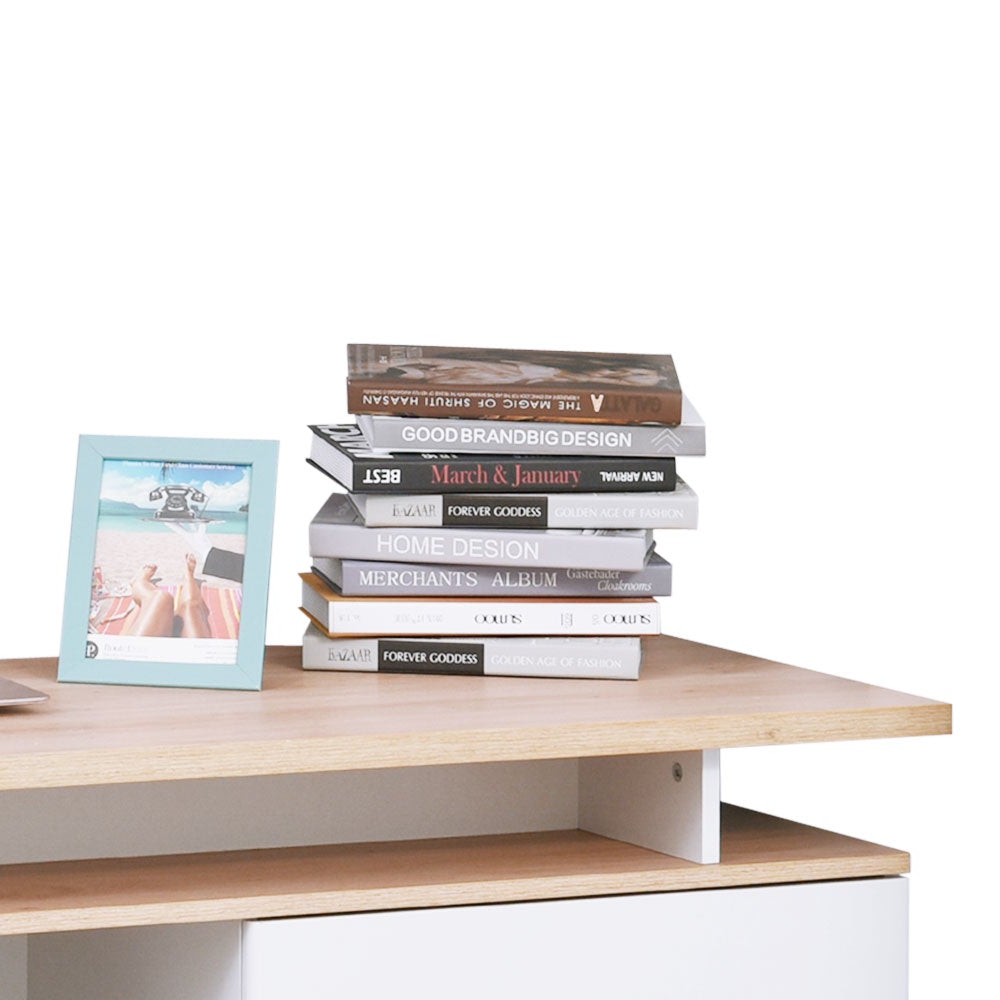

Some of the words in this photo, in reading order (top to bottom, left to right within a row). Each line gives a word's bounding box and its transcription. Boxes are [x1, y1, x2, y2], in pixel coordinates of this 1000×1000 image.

[363, 394, 419, 407] HAASAN
[425, 396, 471, 409] SHRUTI
[477, 397, 501, 409] OF
[503, 398, 552, 410] MAGIC
[558, 399, 582, 411] THE
[402, 426, 456, 444] GOOD
[461, 427, 559, 447] BRANDBIG
[562, 429, 632, 448] DESIGN
[363, 468, 401, 484] BEST
[431, 464, 491, 485] March
[494, 465, 509, 485] &
[512, 464, 582, 488] January
[600, 470, 641, 482] ARRIVAL
[643, 470, 664, 482] NEW
[392, 503, 437, 518] BAZAAR
[447, 504, 491, 518] FOREVER
[494, 505, 542, 519] GODDESS
[555, 506, 598, 519] GOLDEN
[601, 507, 620, 519] AGE
[623, 507, 636, 519] OF
[639, 507, 684, 519] FASHION
[377, 534, 445, 556] HOME
[359, 570, 478, 587] MERCHANTS
[492, 570, 558, 588] ALBUM
[597, 579, 653, 592] Cloakrooms
[327, 648, 372, 662] BAZAAR
[383, 649, 428, 664] FOREVER
[430, 650, 478, 665] GODDESS
[491, 654, 533, 667] GOLDEN
[537, 656, 556, 668] AGE
[559, 656, 573, 668] OF
[577, 656, 622, 669] FASHION
